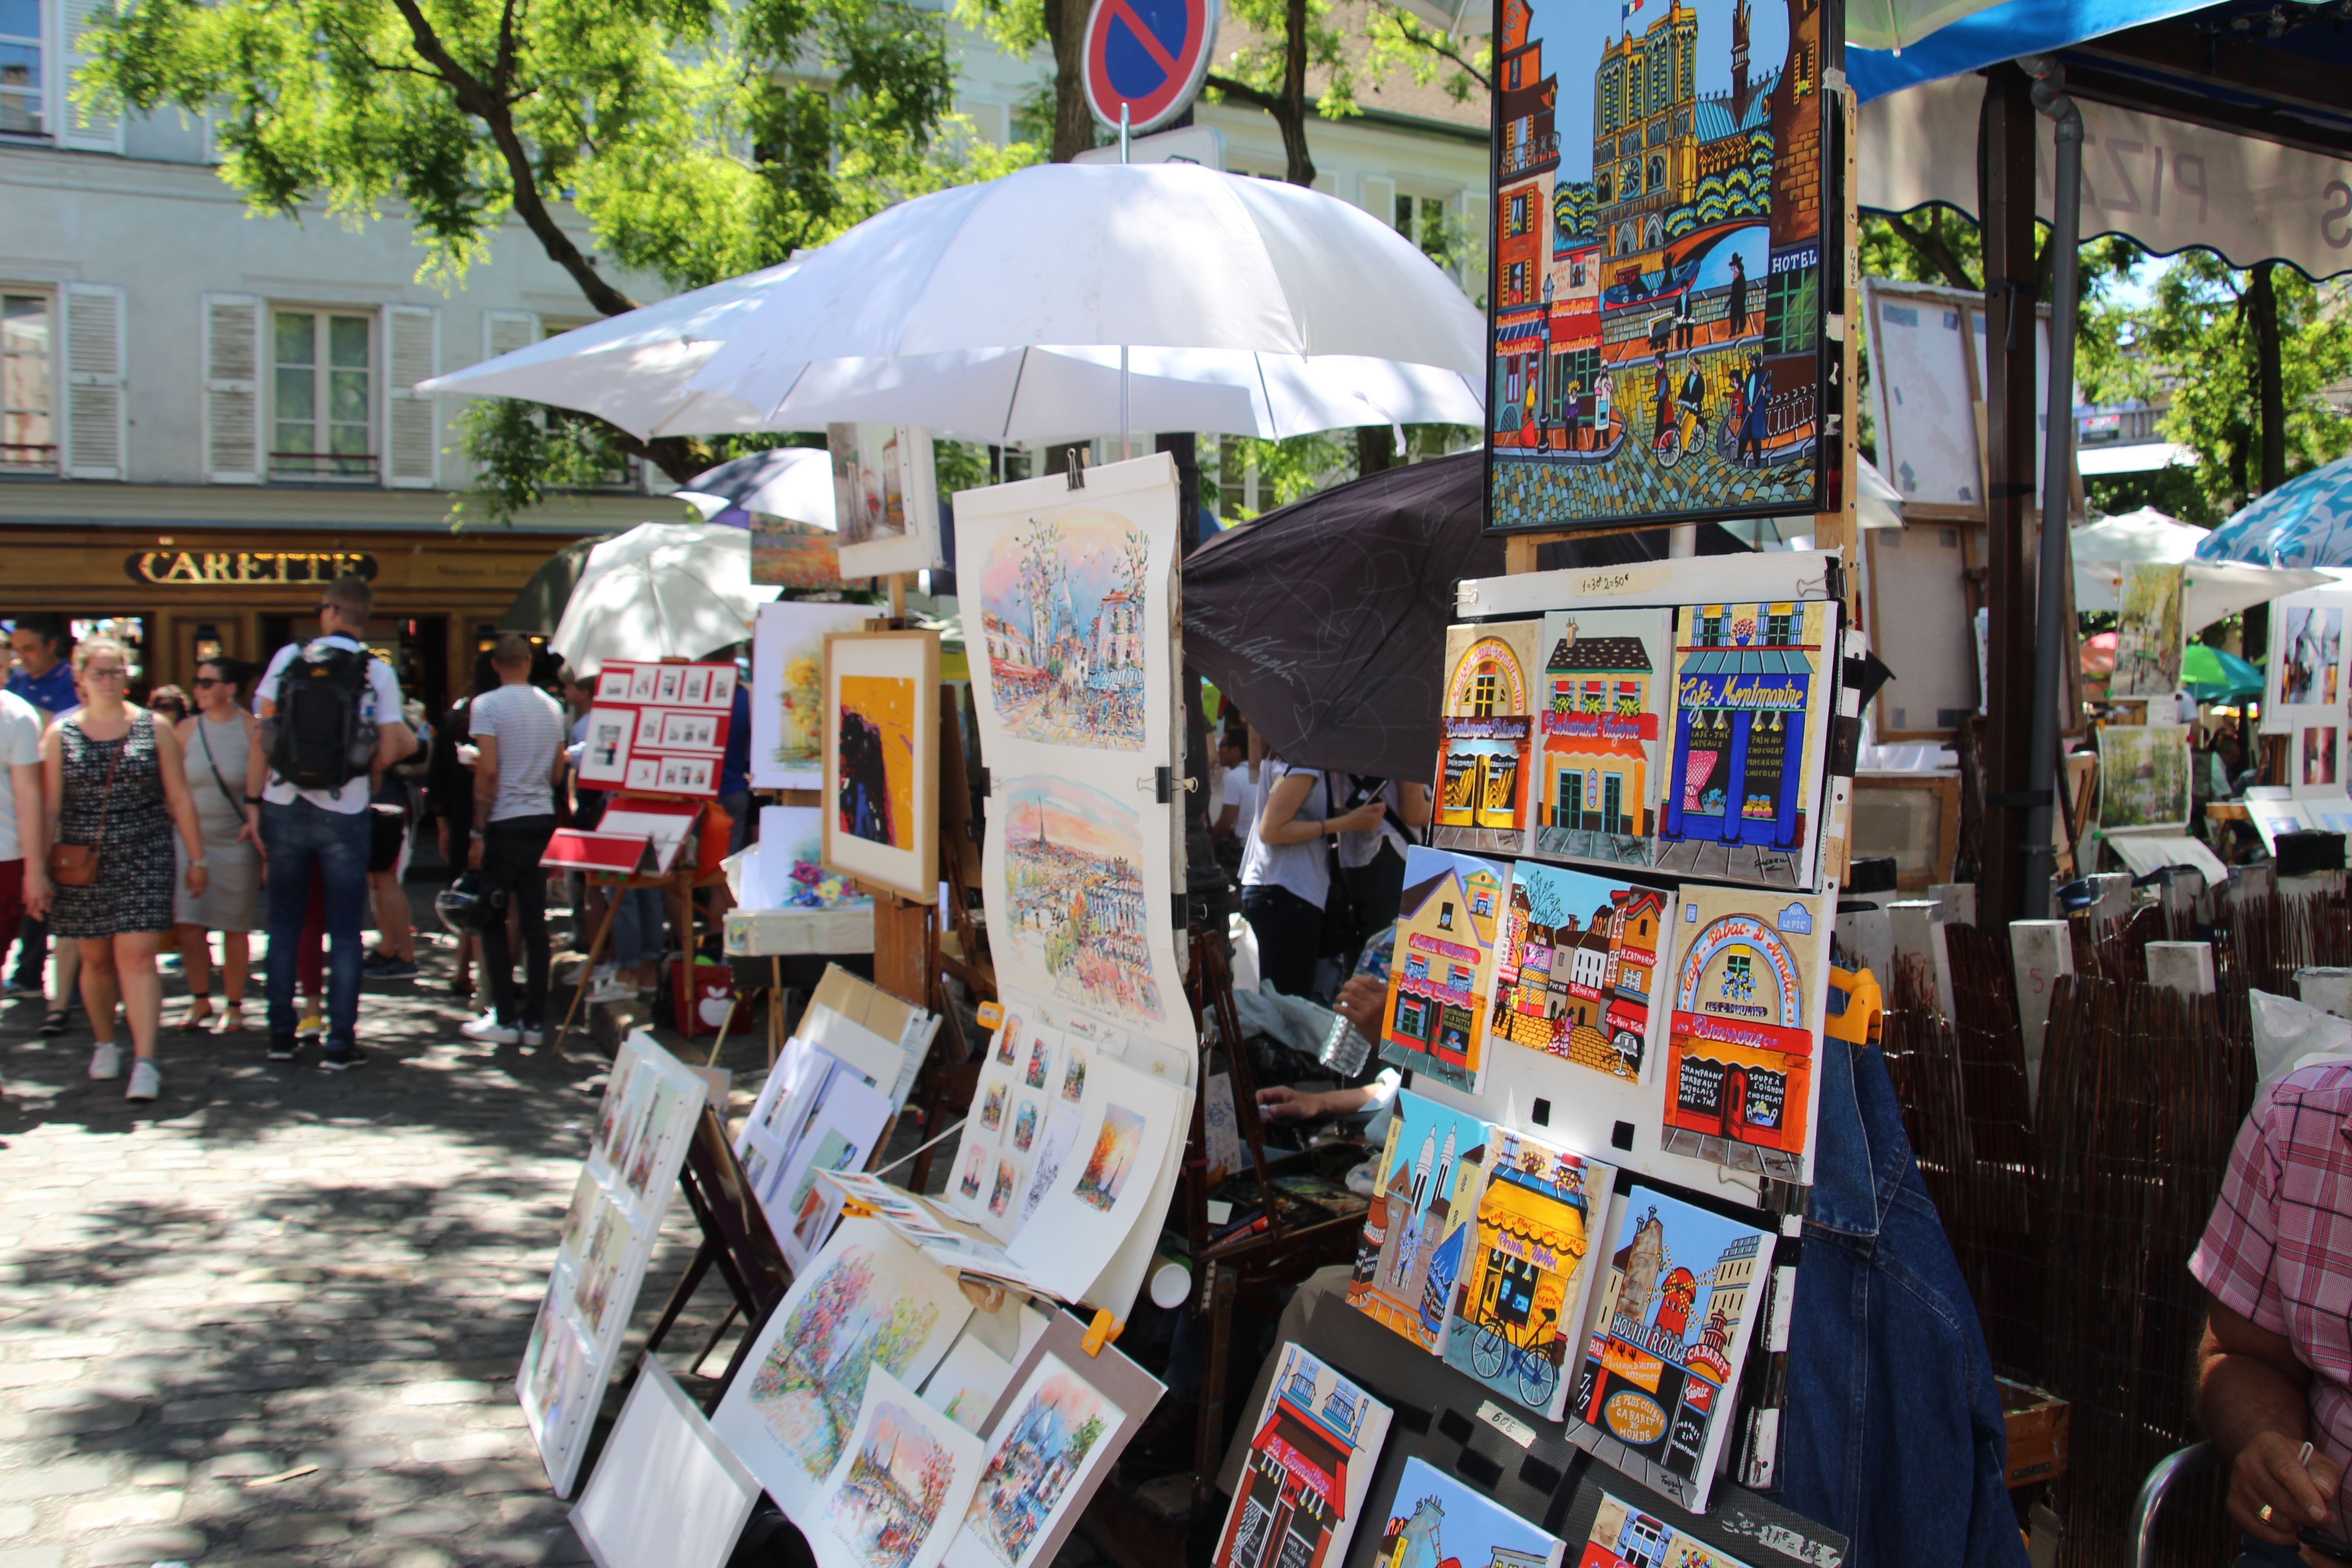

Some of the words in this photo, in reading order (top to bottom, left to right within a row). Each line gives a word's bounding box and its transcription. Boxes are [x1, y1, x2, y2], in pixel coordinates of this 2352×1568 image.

[1772, 250, 1817, 274] HOTEL
[1552, 298, 1593, 318] Boucherie
[138, 552, 363, 584] CARETTE
[1747, 759, 1784, 767] MACARONS
[1688, 908, 1695, 920] 13
[1789, 906, 1802, 915] RUE
[1681, 1064, 1724, 1080] CHAMPAGNE
[1749, 1073, 1773, 1084] SOUPE
[1680, 1073, 1718, 1088] BORDEAUX
[1747, 1091, 1782, 1105] CHOCOLAT
[1467, 1249, 1485, 1311] LOCATION
[1588, 1340, 1604, 1357] BAR
[1649, 1332, 1687, 1365] ROUGE
[1687, 1346, 1728, 1375] CABARET
[1611, 1396, 1621, 1408] LE
[1623, 1395, 1640, 1407] PLUS
[1616, 1408, 1655, 1426] CABARET
[1619, 1427, 1651, 1441] MONDE
